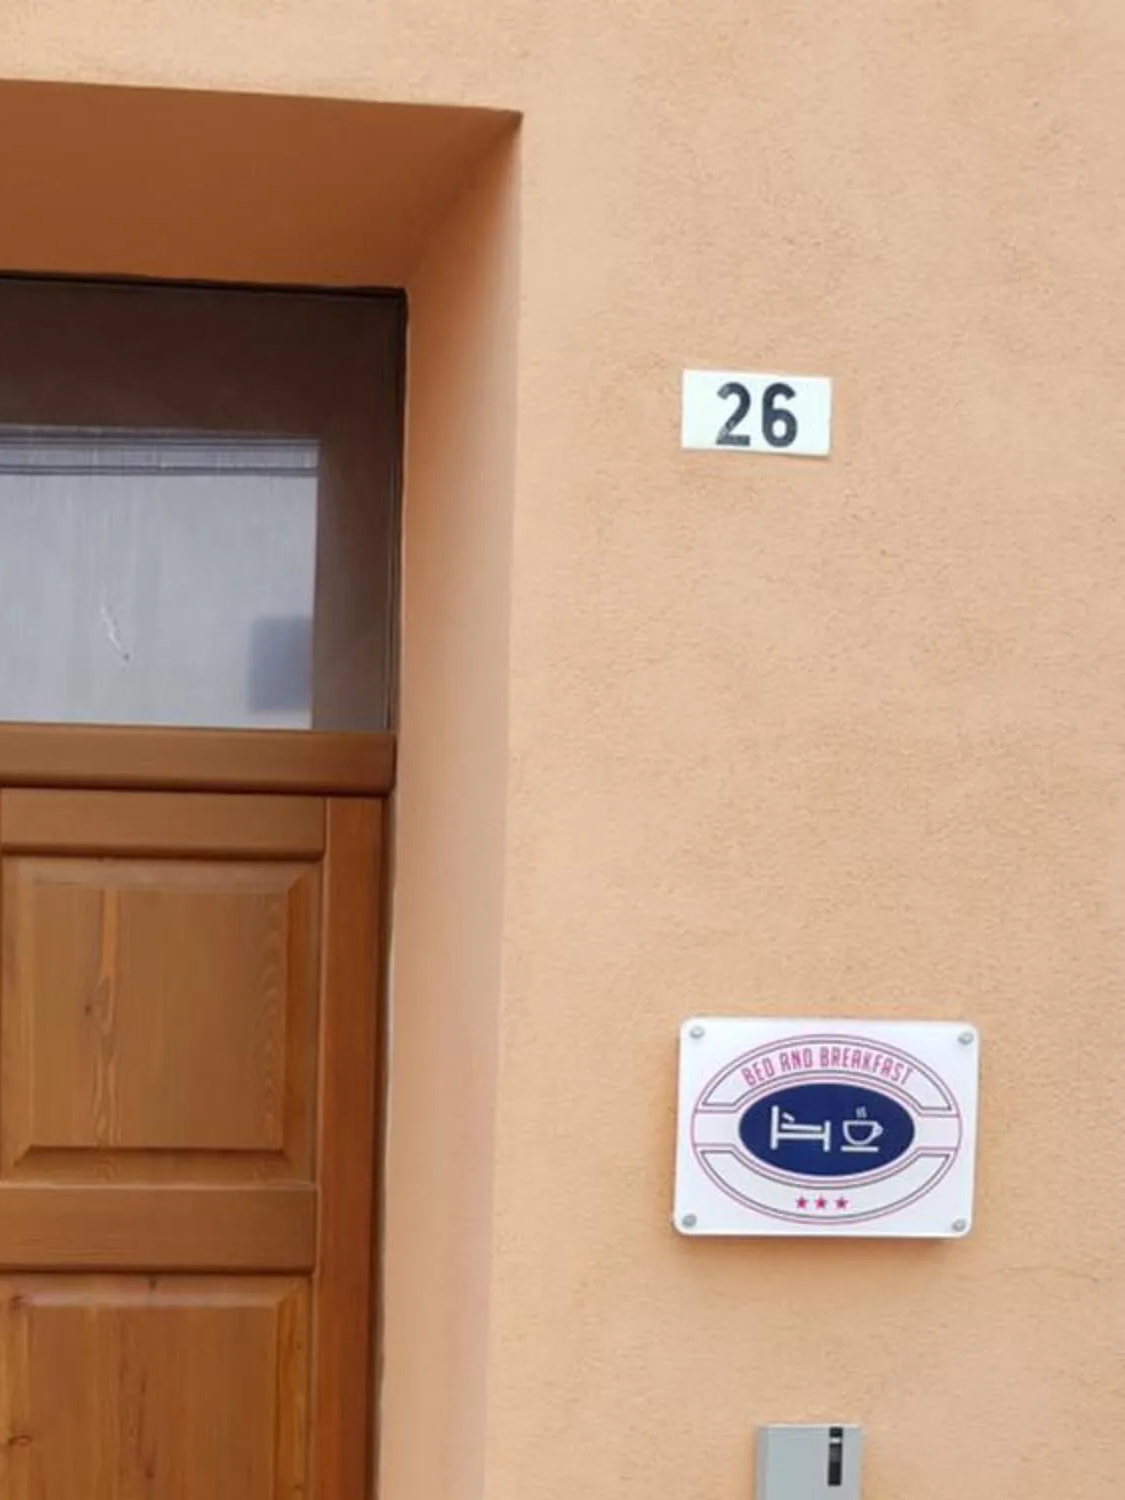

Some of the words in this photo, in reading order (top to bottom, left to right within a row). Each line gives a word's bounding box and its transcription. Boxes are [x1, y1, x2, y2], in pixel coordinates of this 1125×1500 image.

[715, 381, 798, 448] 26
[741, 1058, 774, 1086] BED
[779, 1048, 814, 1071] AND
[820, 1046, 913, 1085] BREAKFAST
